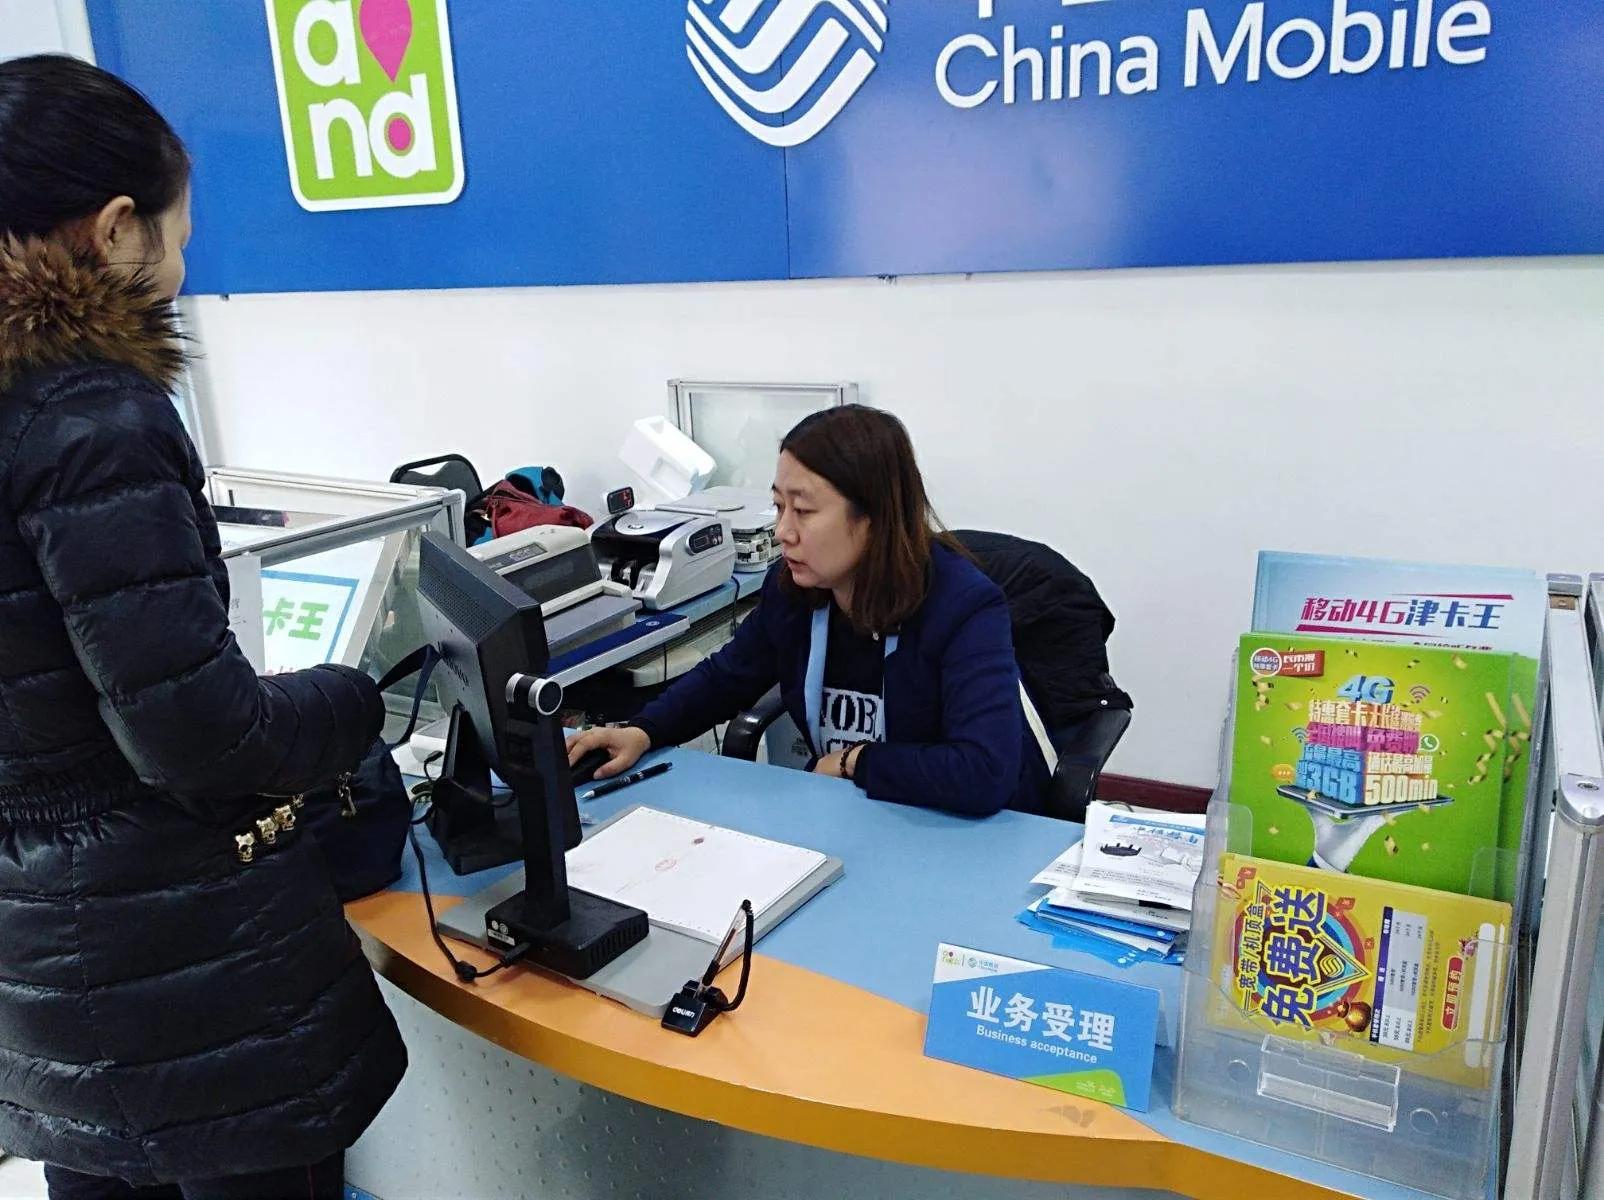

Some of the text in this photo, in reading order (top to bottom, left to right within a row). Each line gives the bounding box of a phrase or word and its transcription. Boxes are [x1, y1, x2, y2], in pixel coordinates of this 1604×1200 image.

[935, 0, 1491, 109] China Mobile
[263, 598, 329, 640] 卡王
[1301, 597, 1505, 629] 移动4G津卡王
[1337, 675, 1394, 705] 4G
[1364, 774, 1438, 806] 500min
[1240, 905, 1263, 990] 宽带/机顶盒
[1262, 887, 1325, 1031] 免费送
[966, 985, 1115, 1051] 业务受理
[976, 1024, 1098, 1064] Business acceptance
